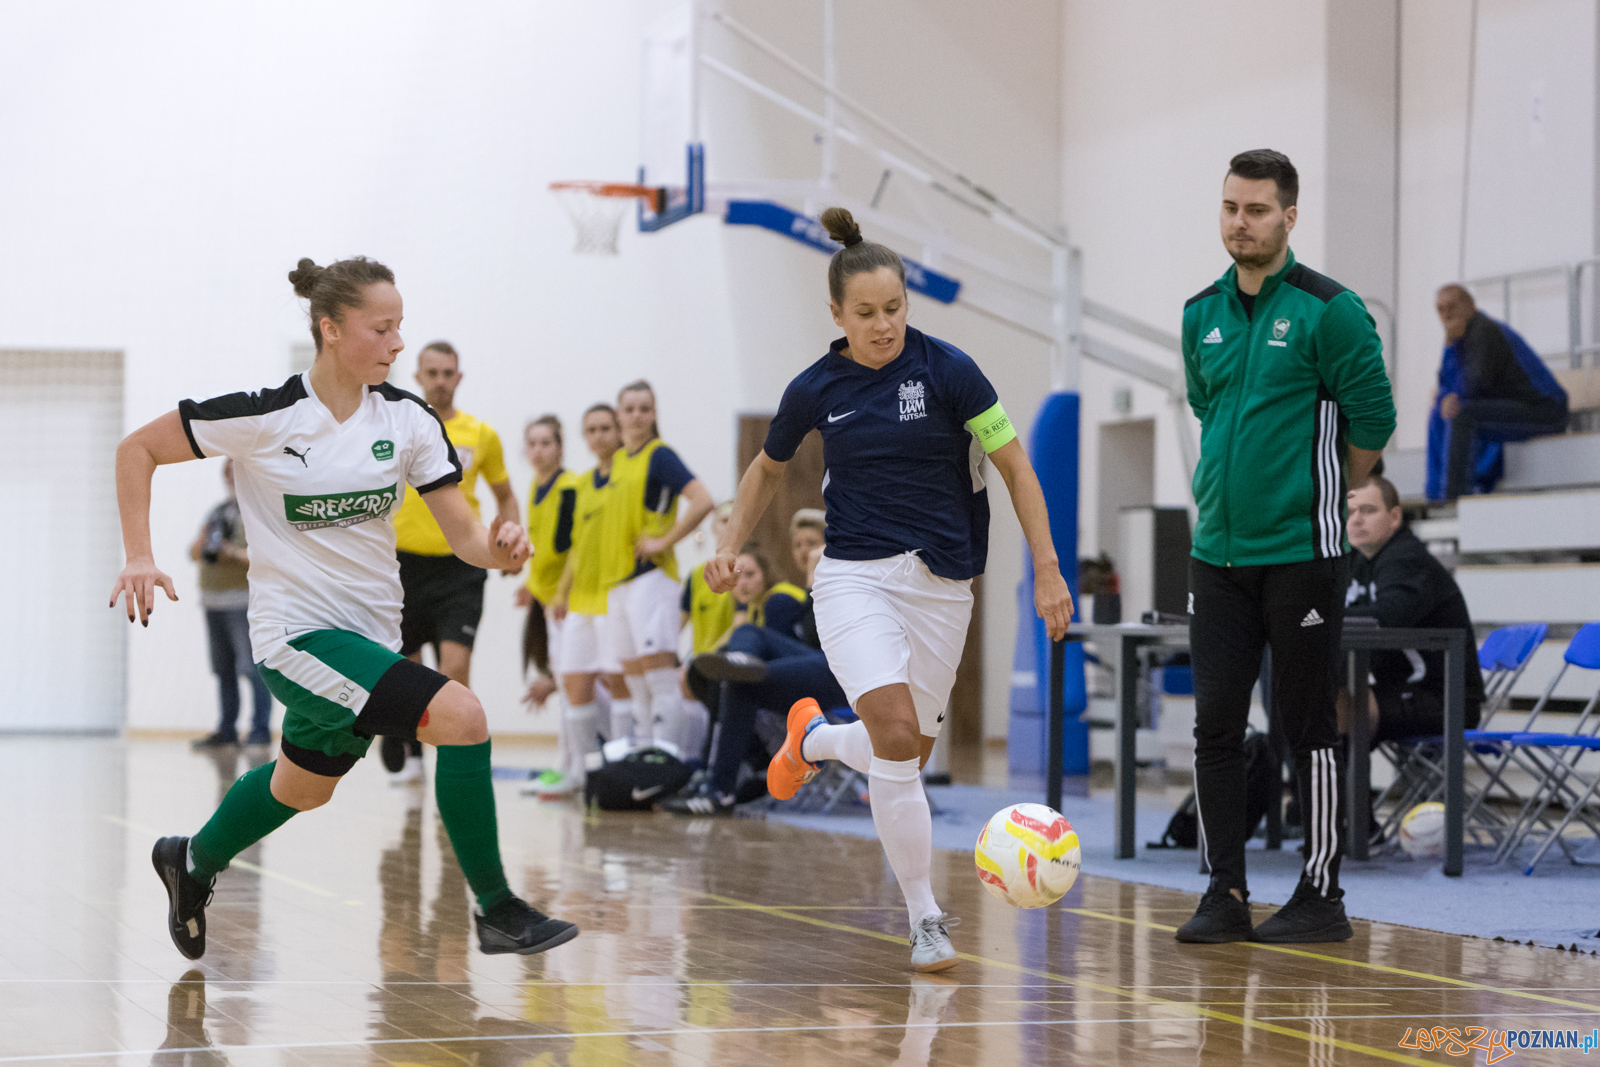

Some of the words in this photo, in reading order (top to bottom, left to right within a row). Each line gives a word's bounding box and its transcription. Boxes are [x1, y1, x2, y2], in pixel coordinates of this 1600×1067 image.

[899, 398, 926, 415] UAM
[899, 410, 928, 422] FUTSAL
[310, 492, 394, 520] REKORD
